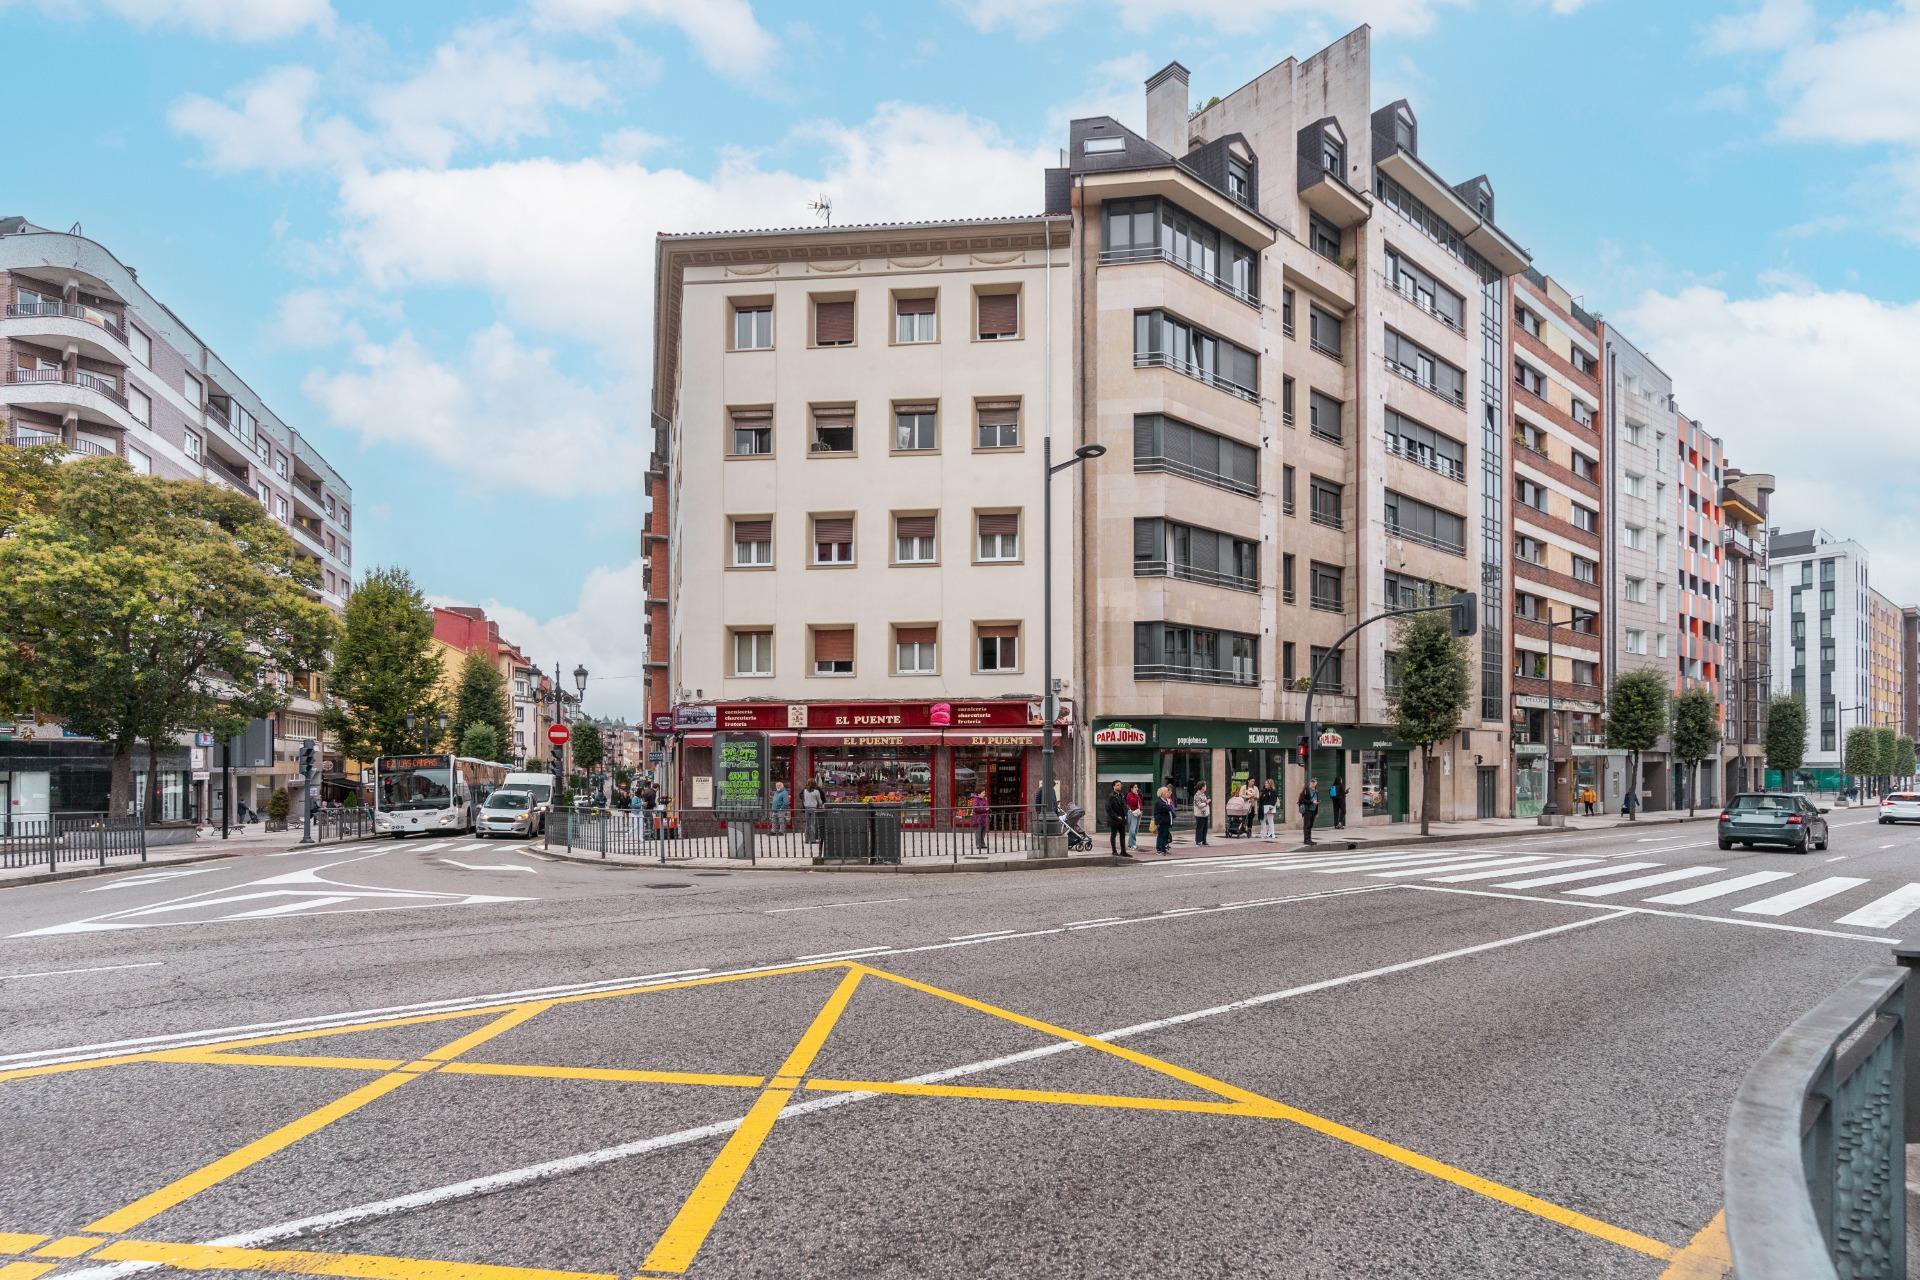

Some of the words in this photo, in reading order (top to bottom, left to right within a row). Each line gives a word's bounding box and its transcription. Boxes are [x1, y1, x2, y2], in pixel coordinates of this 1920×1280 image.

[835, 716, 850, 725] EL
[854, 715, 901, 724] PUENTE
[843, 737, 857, 745] EL
[860, 737, 904, 745] PUENTE
[971, 736, 986, 745] EL
[987, 736, 1033, 745] PUENTE
[1096, 731, 1116, 742] PAPA
[1177, 736, 1208, 746] papajohns.es
[1248, 734, 1265, 744] MEJOR
